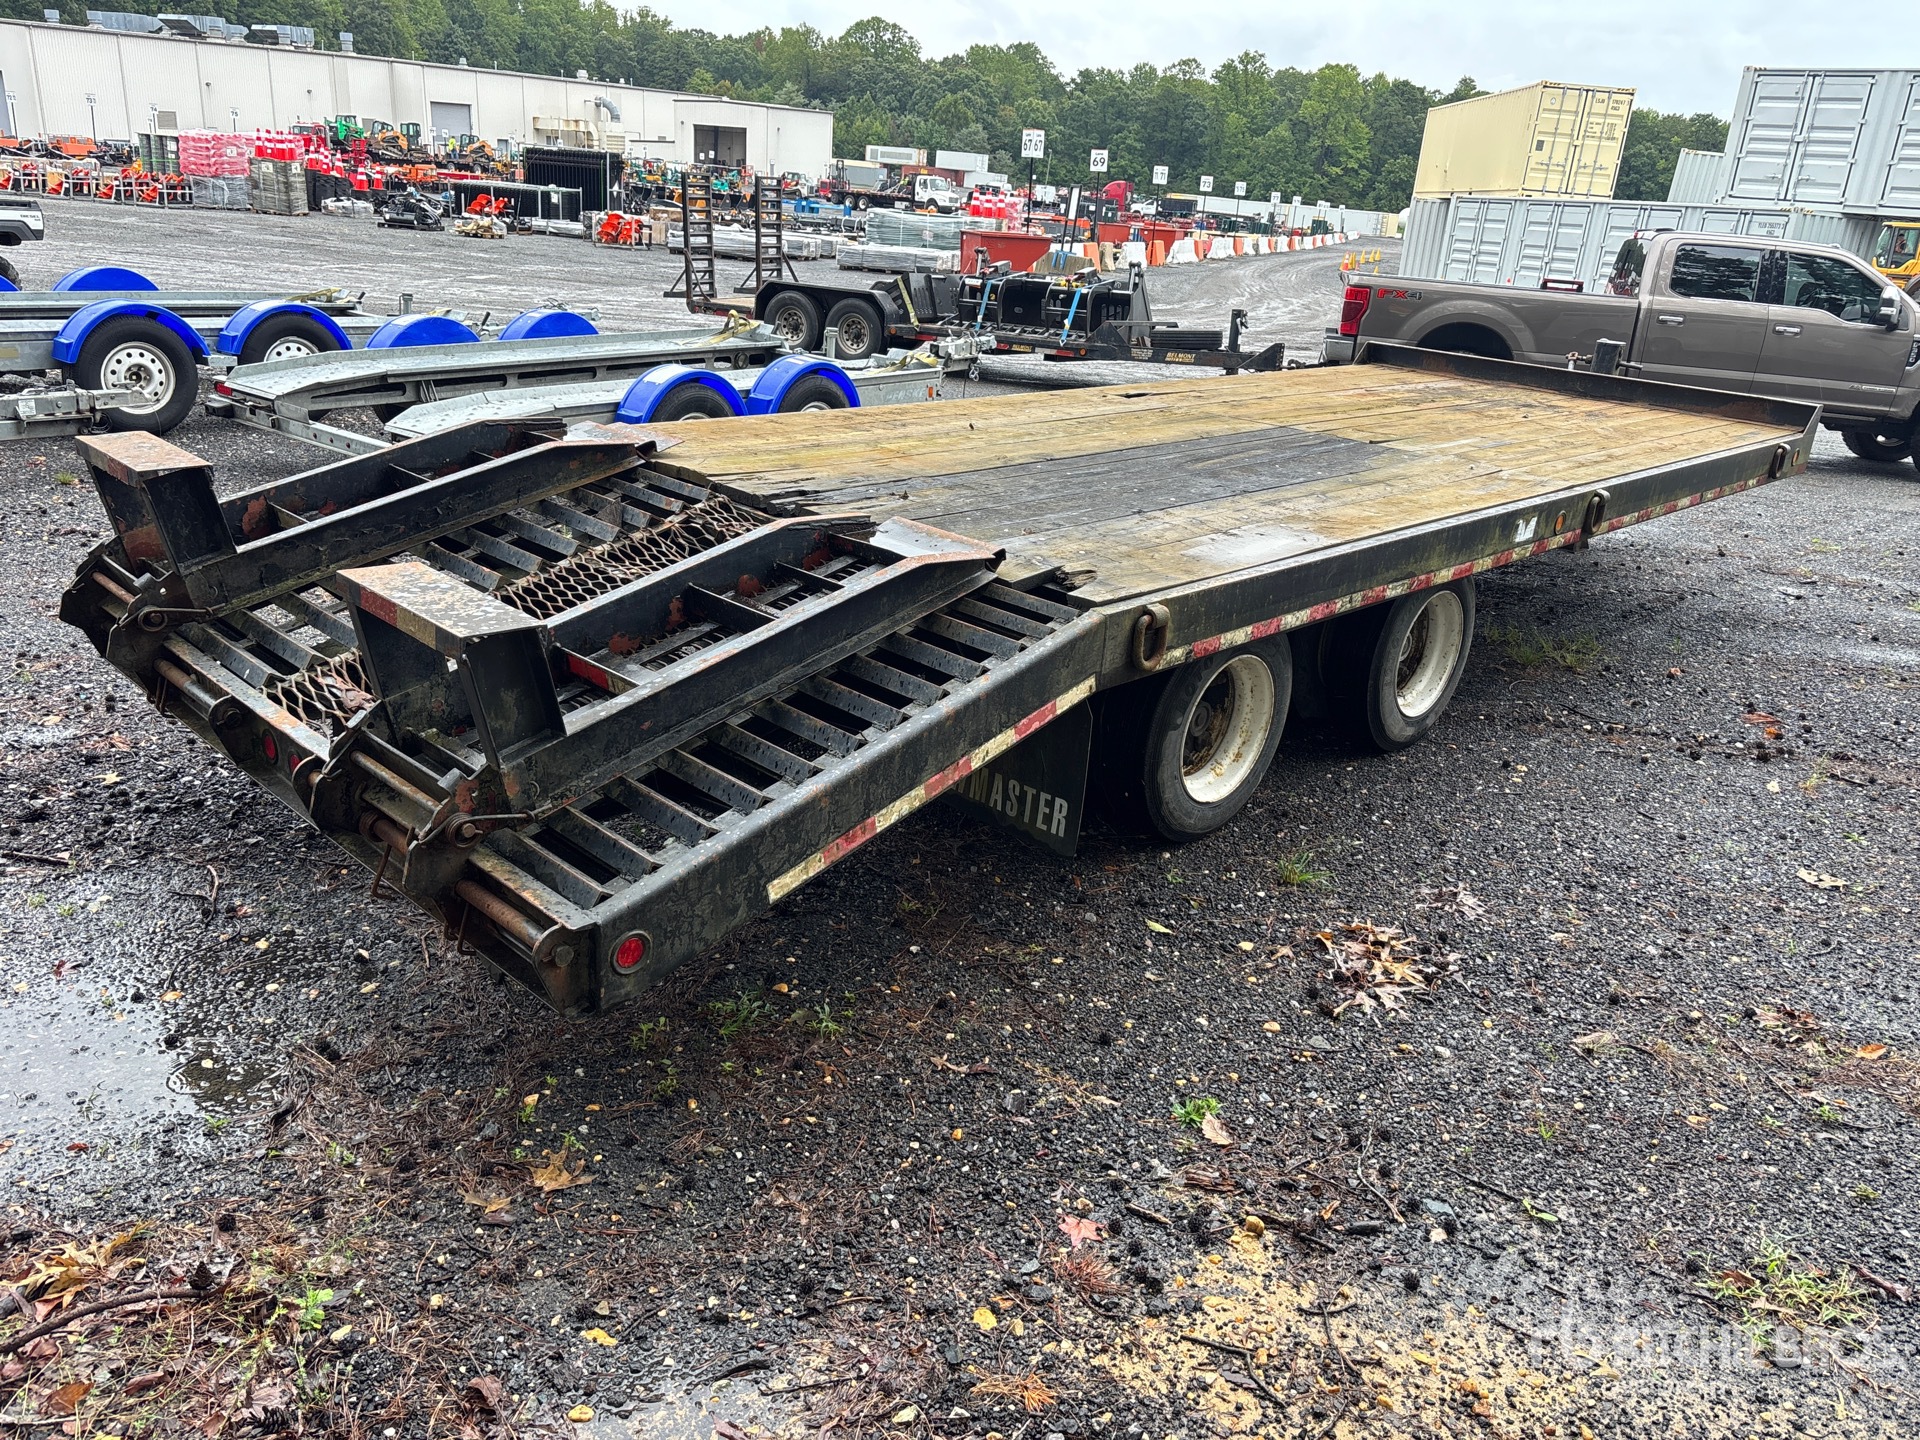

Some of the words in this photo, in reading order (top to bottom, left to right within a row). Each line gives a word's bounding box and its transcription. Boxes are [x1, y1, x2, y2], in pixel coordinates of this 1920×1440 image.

[1023, 139, 1032, 151] 67
[1033, 139, 1043, 152] 67
[1092, 157, 1106, 167] 69
[1202, 181, 1211, 189] 73
[1377, 288, 1423, 301] FX4
[1166, 352, 1196, 360] BELMONT
